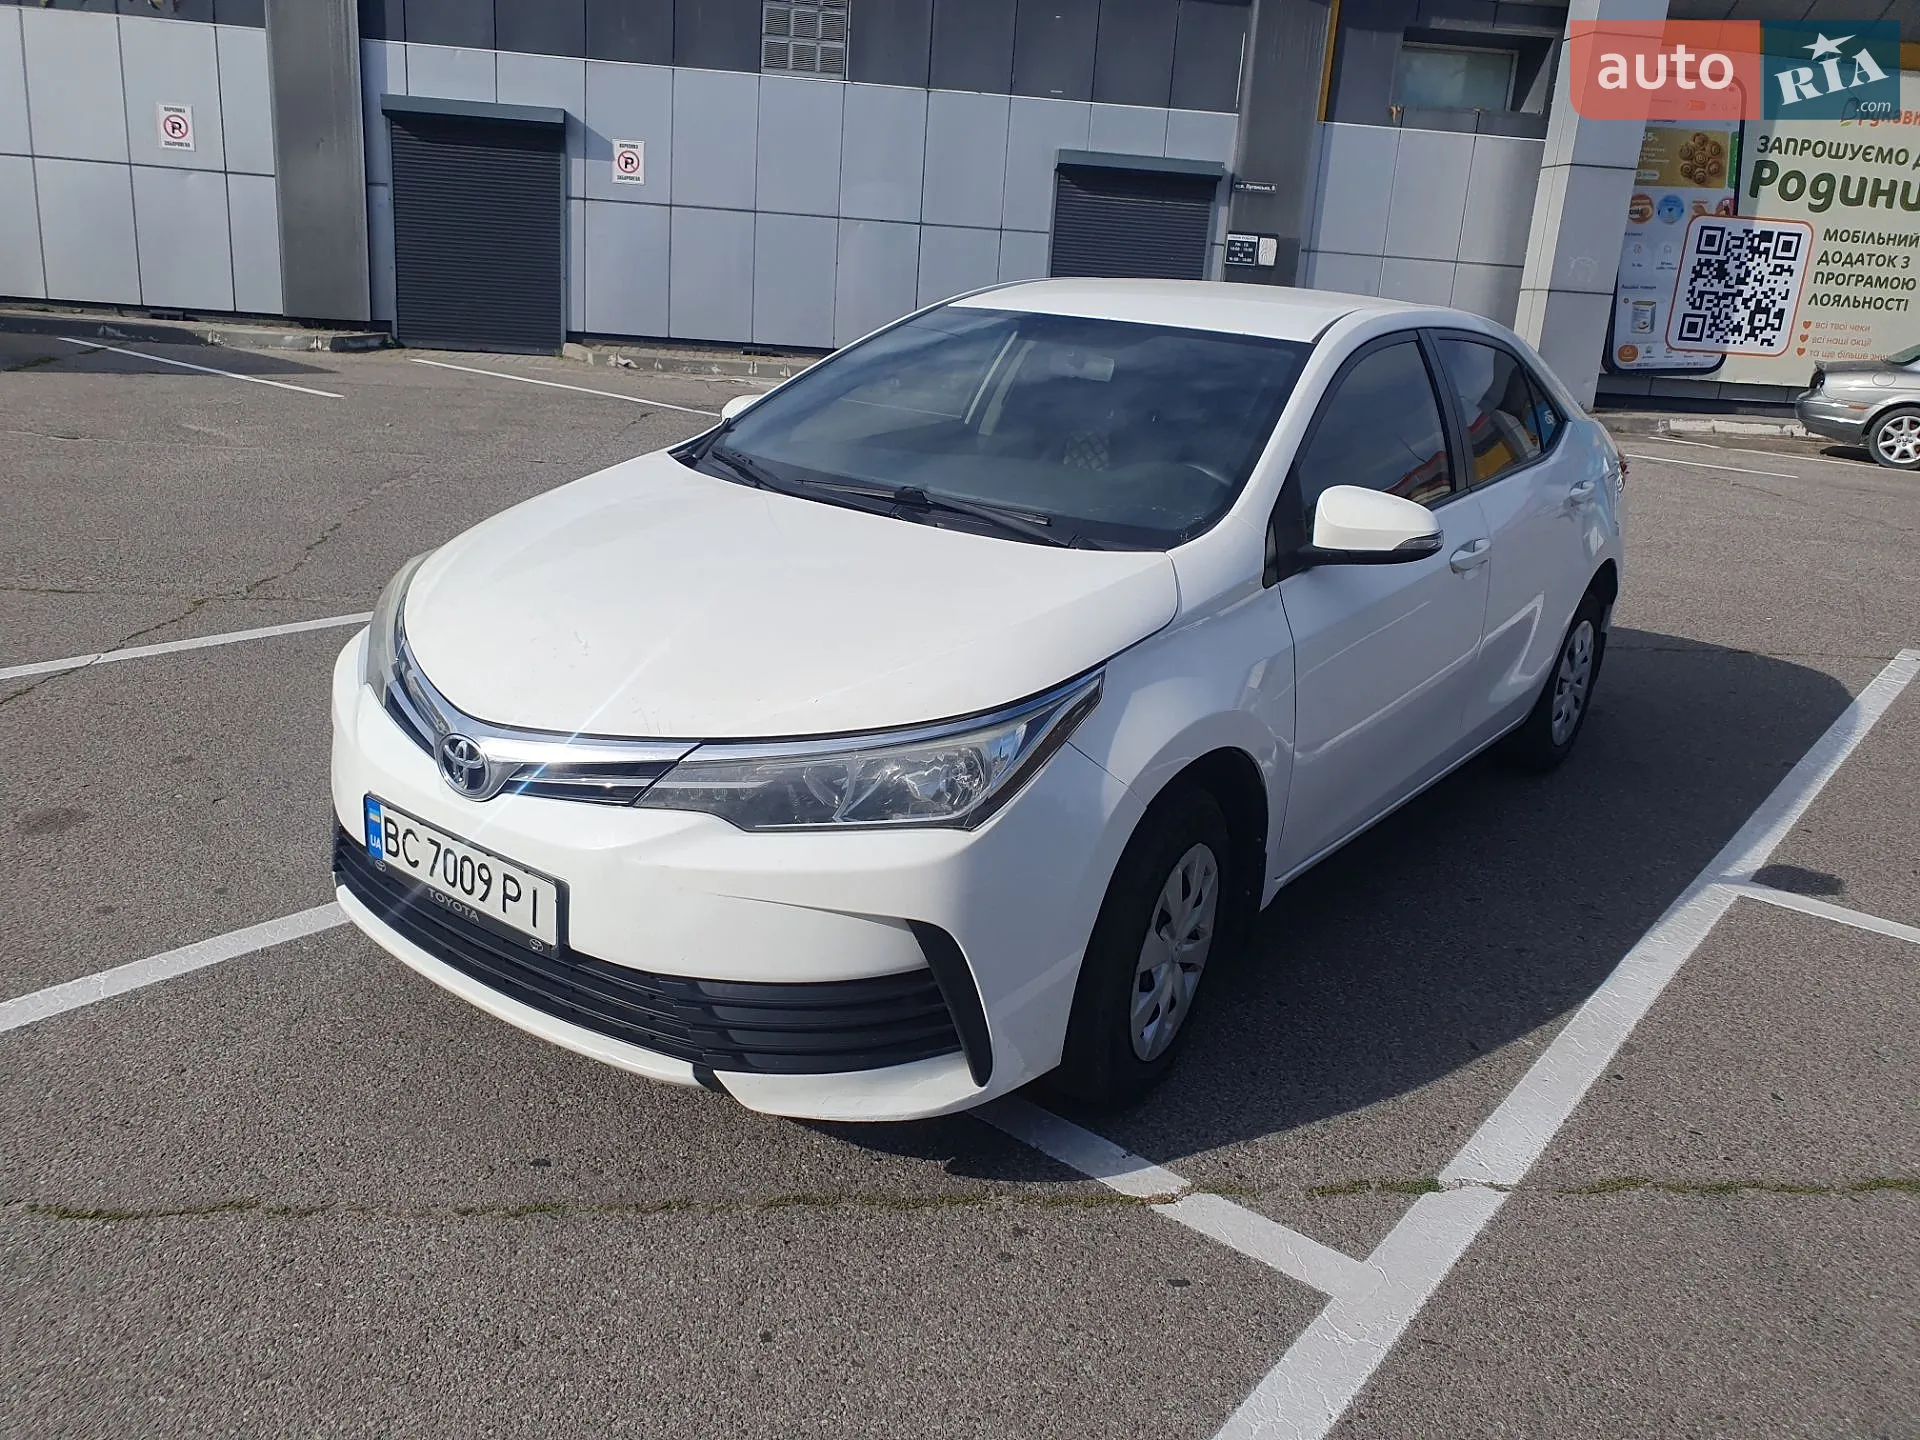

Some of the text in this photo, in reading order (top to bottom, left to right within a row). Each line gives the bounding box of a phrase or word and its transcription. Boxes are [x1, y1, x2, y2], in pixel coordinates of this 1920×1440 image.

[1757, 136, 1909, 165] ЗАПРОШУЄМО
[1823, 228, 1920, 248] МОБІЛЬНИЙ
[1817, 250, 1910, 269] ДОДАТОК З
[1813, 271, 1916, 291] ПРОГРАМОЮ
[1808, 293, 1909, 312] ЛОЯЛЬНОСТІ
[370, 834, 382, 850] UA
[384, 815, 538, 928] BC 7009 PI
[427, 887, 480, 922] TOYOTA
